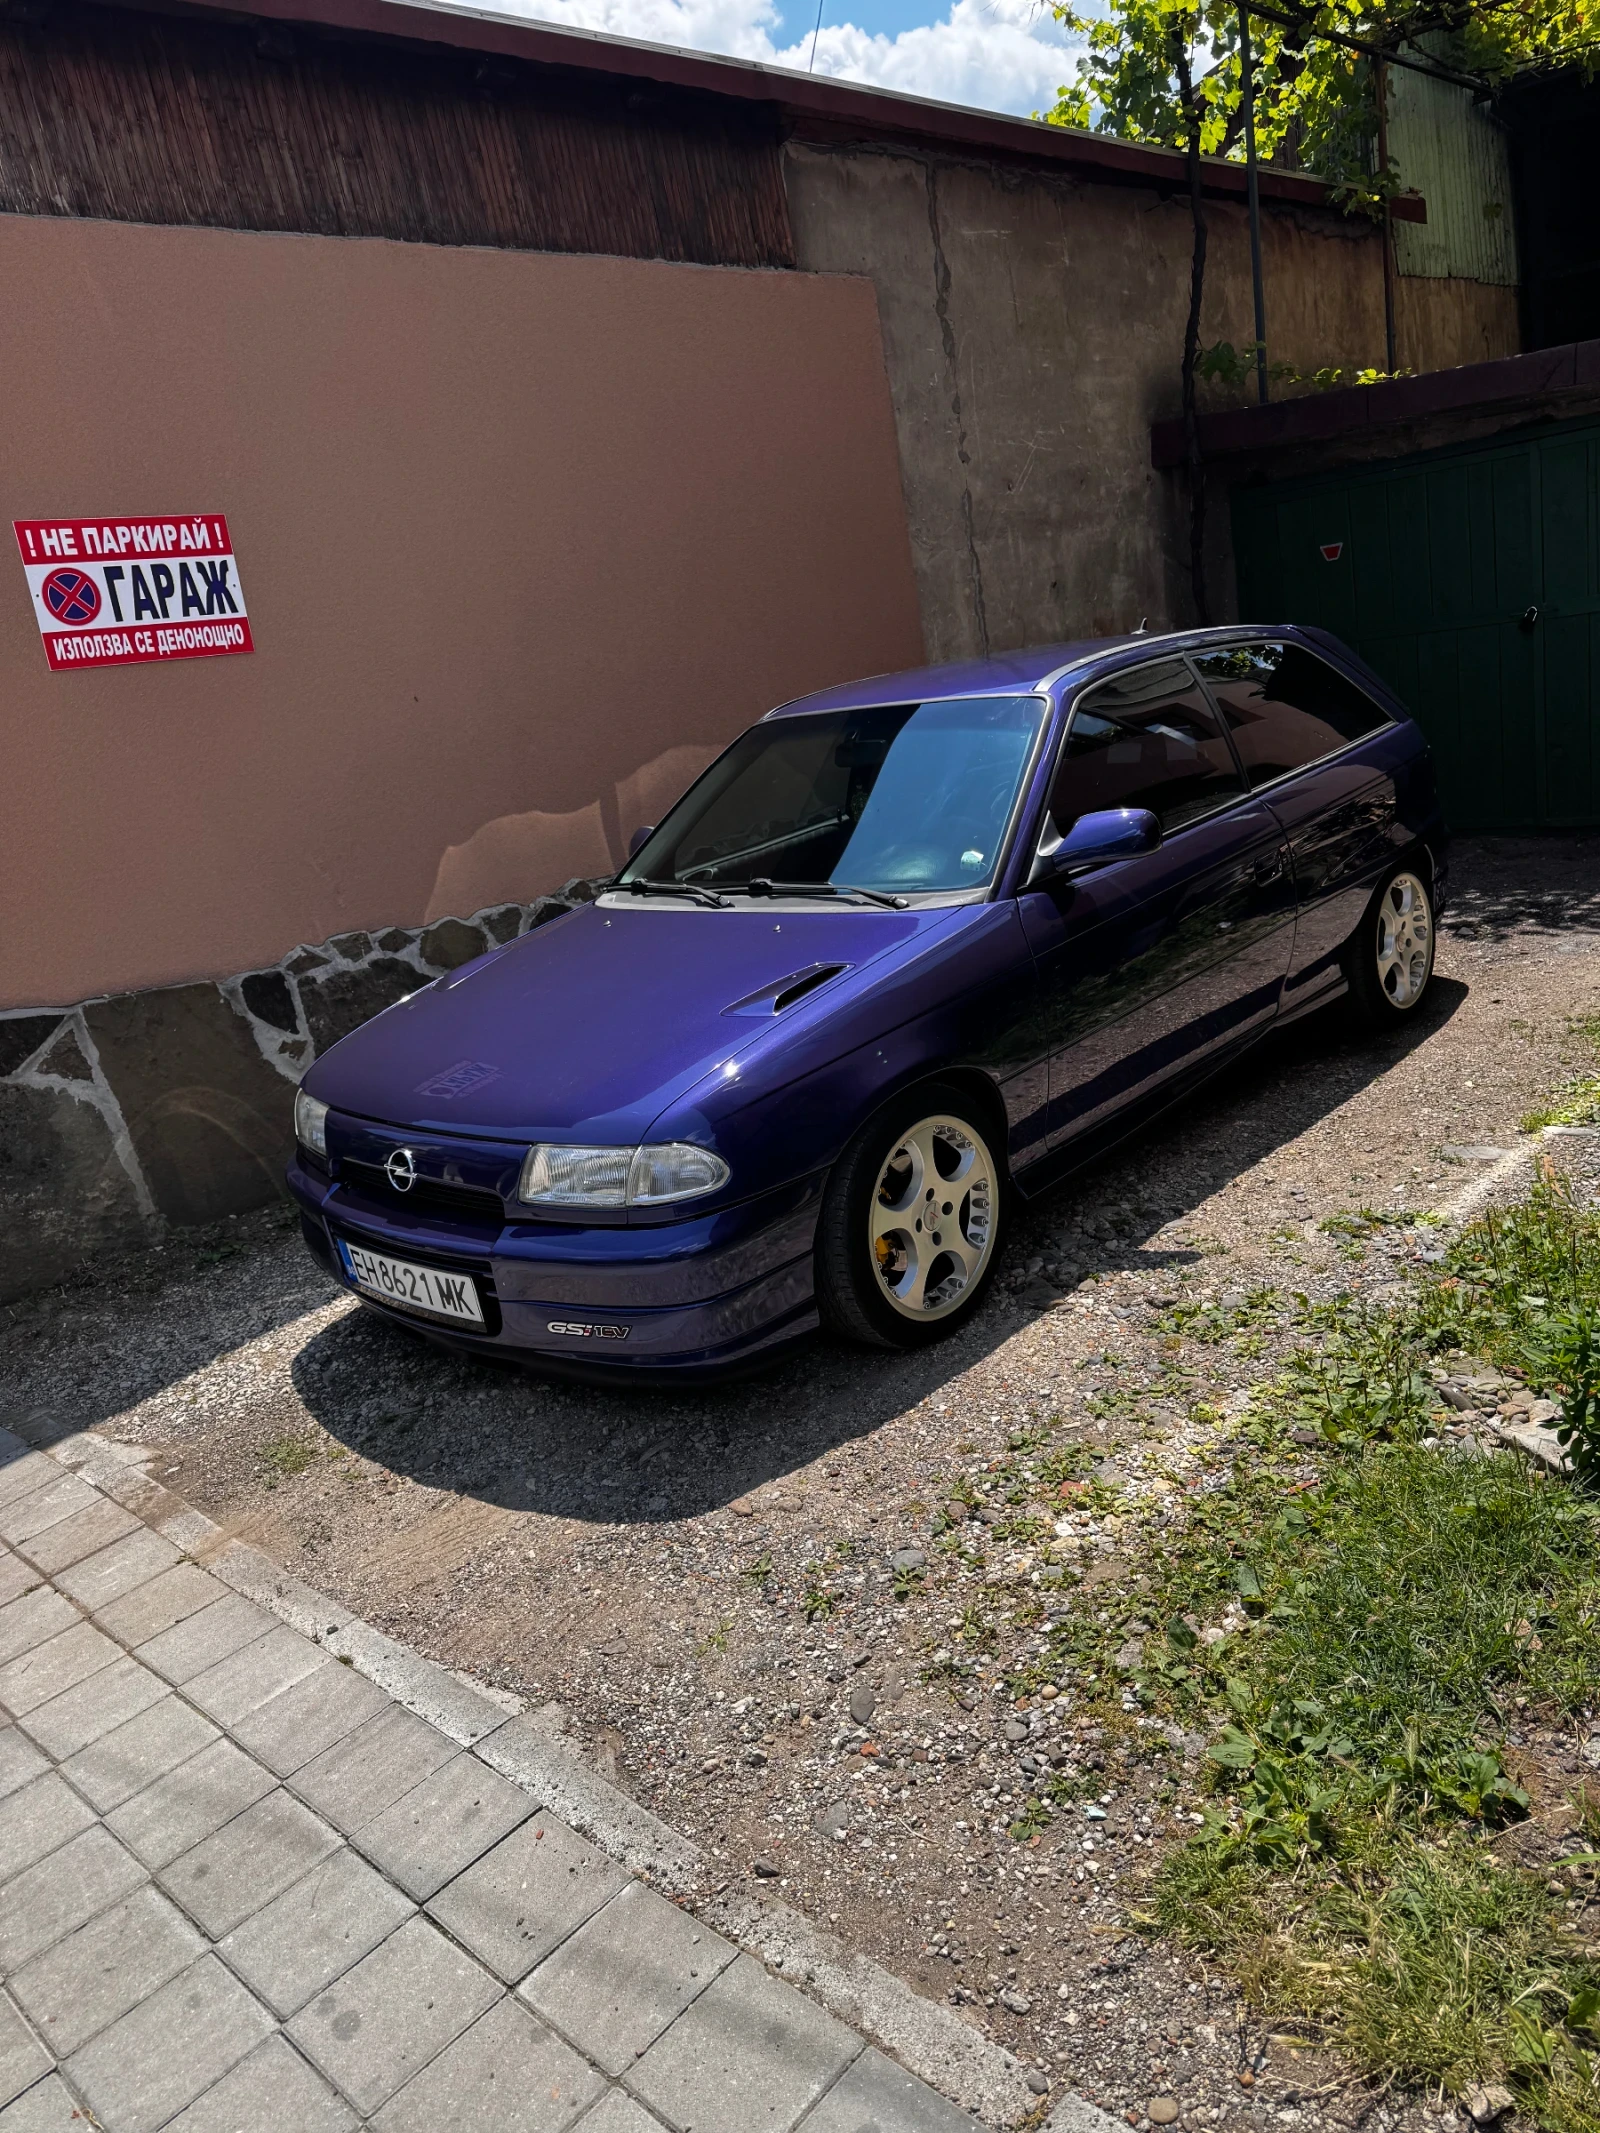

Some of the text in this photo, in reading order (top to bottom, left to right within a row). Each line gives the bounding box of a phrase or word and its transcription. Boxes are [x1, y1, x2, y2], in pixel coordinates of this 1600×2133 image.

[40, 528, 79, 556] НЕ
[81, 517, 212, 555] ПАРКИРАЙ
[102, 559, 239, 622] ГАРАЖ
[52, 623, 245, 661] ИЗПОЛЗВА СЕ ДЕНОНОЩНО
